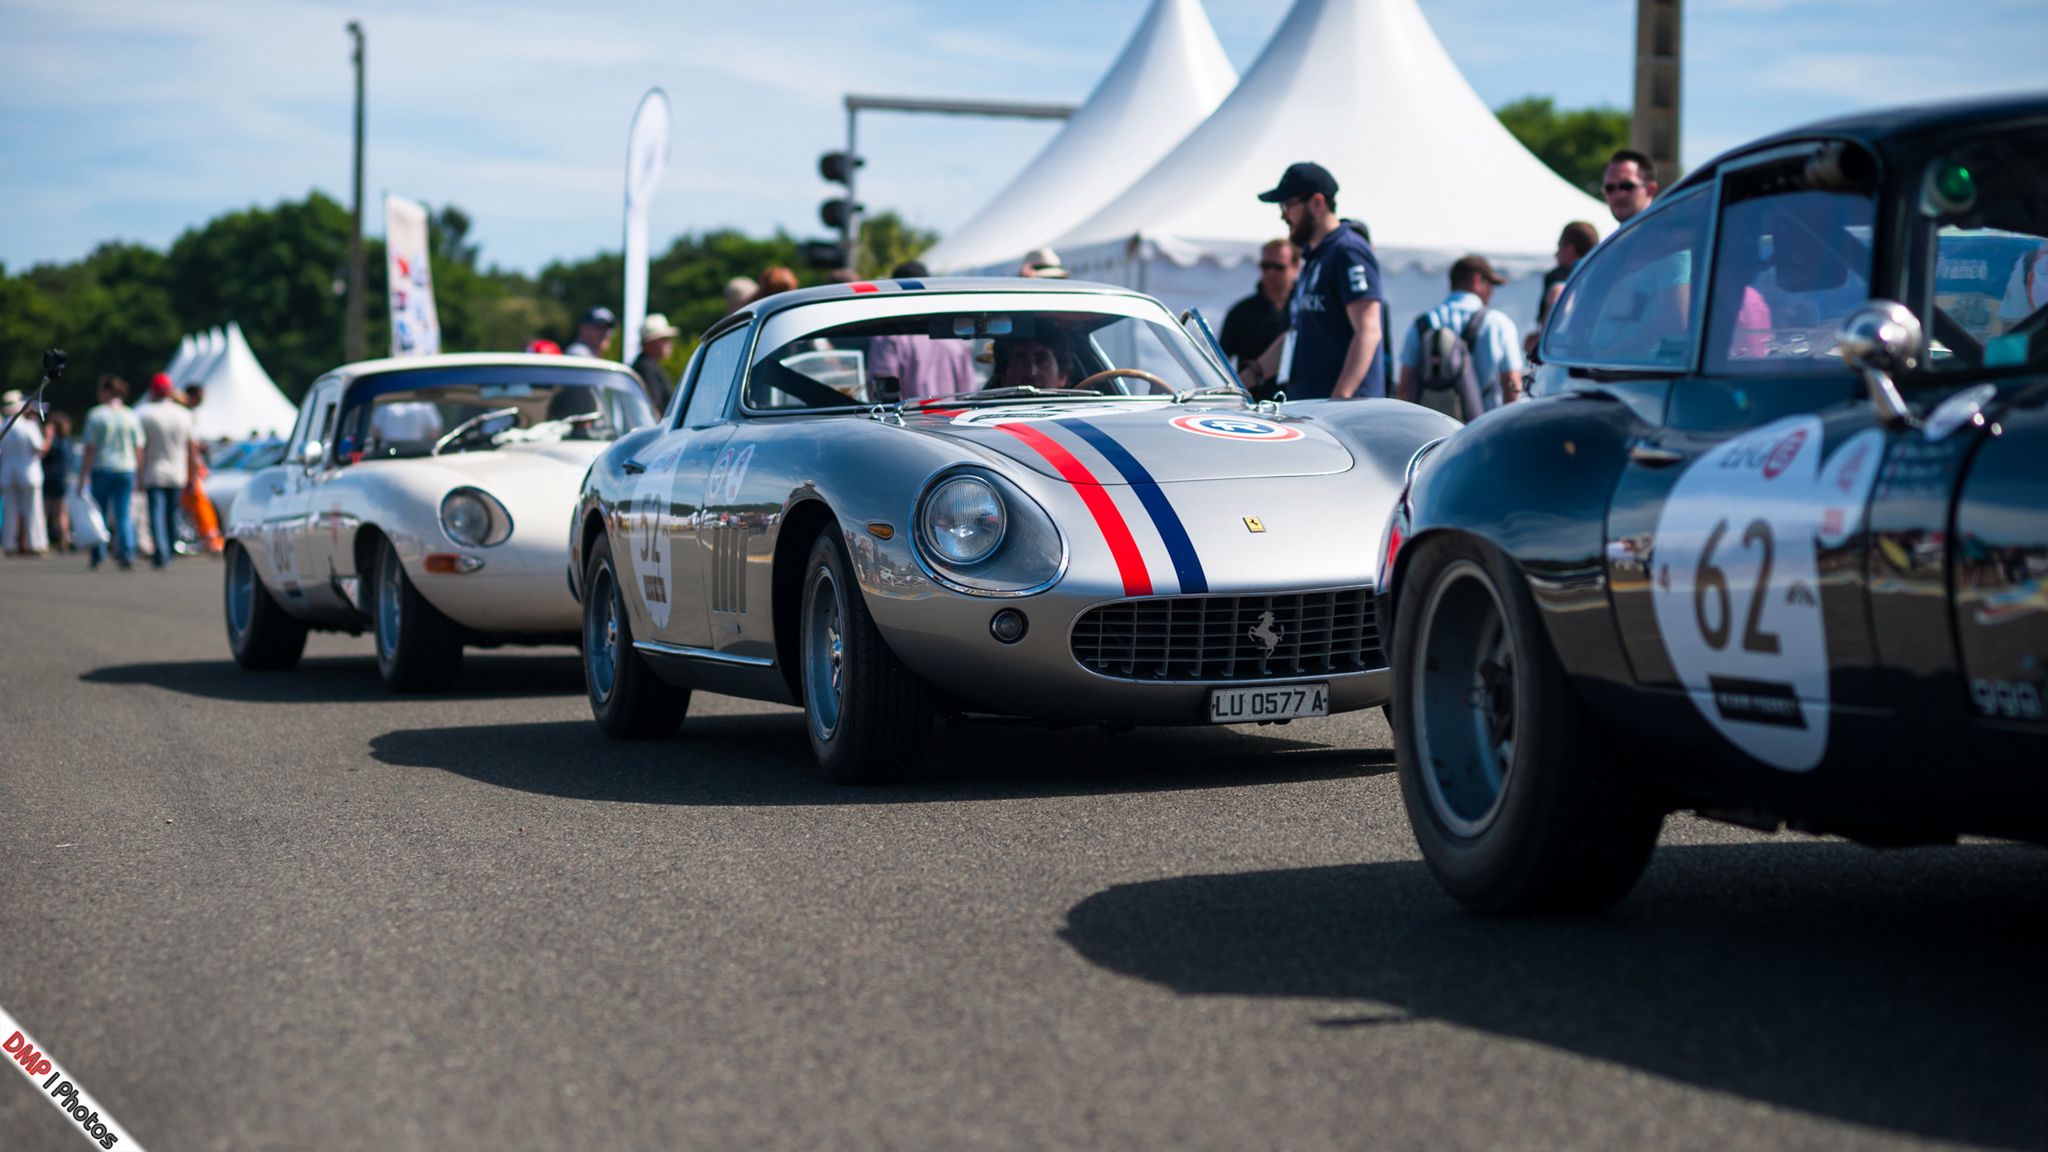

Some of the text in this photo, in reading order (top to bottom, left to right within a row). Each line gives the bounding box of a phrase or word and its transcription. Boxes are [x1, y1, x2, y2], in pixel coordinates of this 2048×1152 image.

[640, 492, 661, 563] 52
[1694, 517, 1782, 656] 62
[1215, 690, 1323, 717] LU 0577 A
